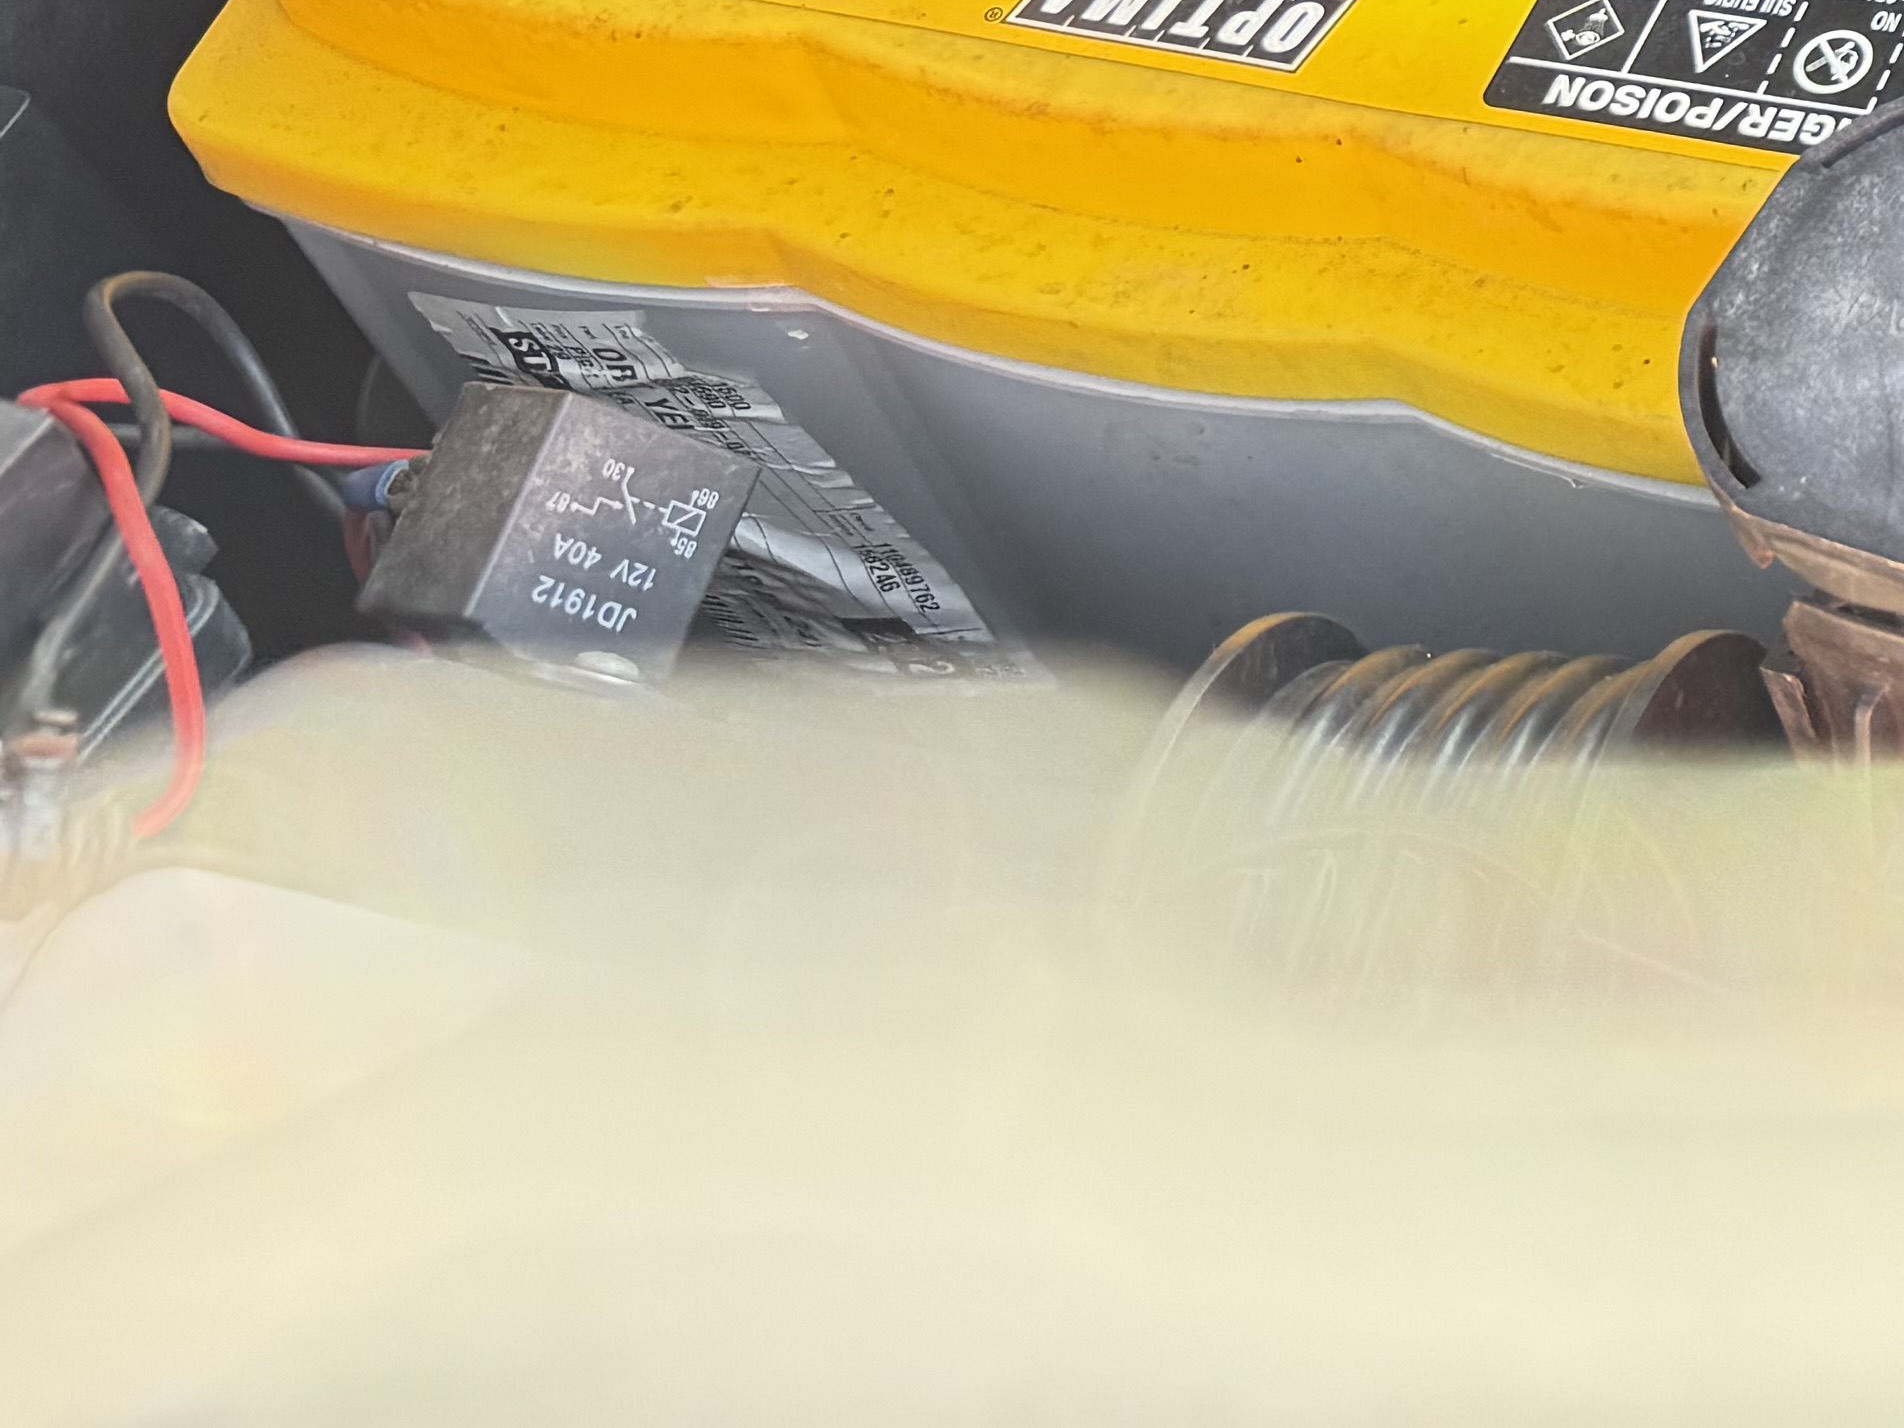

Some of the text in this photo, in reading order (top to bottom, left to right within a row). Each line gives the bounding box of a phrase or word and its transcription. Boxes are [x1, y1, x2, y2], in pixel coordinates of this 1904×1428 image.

[1869, 10, 1902, 32] NO
[1545, 68, 1847, 144] GER/POISON
[549, 533, 656, 589] 12V 40A
[532, 575, 635, 630] JD1912
